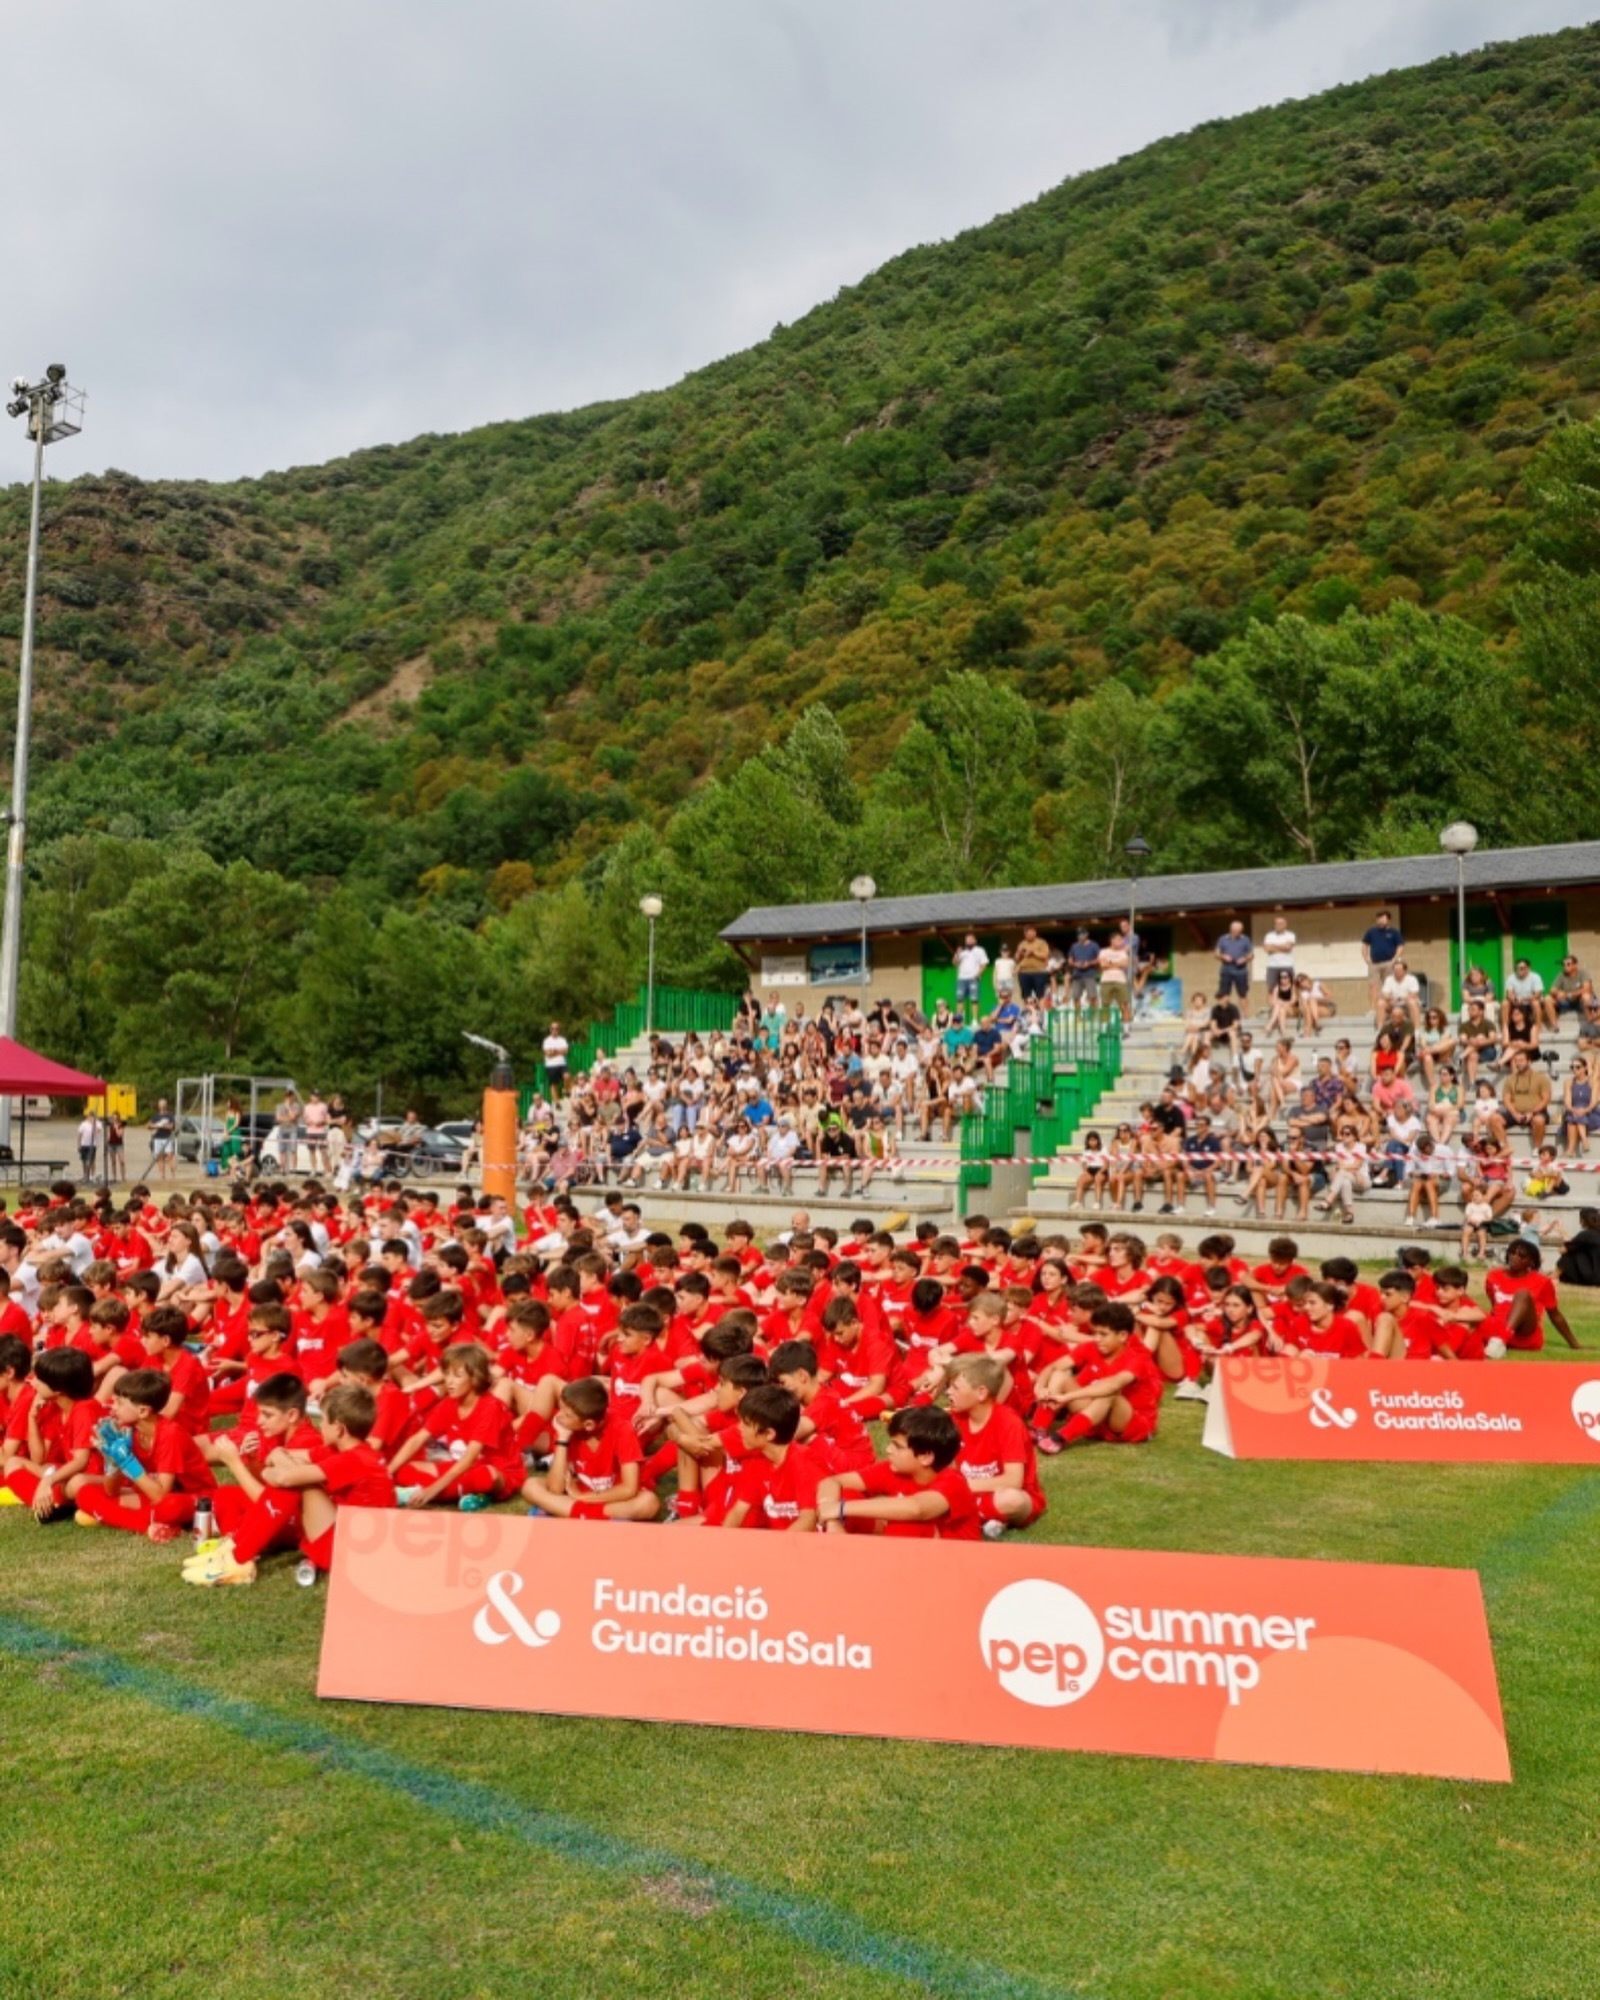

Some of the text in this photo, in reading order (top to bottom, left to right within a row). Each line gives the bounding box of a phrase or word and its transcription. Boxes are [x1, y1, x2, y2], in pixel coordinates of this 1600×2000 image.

[1369, 1389, 1463, 1409] Fundació
[1373, 1411, 1522, 1431] GuardiolaSala
[593, 1579, 768, 1621] Fundació
[591, 1619, 872, 1669] GuardiolaSala
[1104, 1605, 1316, 1651] summer
[989, 1638, 1088, 1691] pep
[1107, 1646, 1260, 1705] camp
